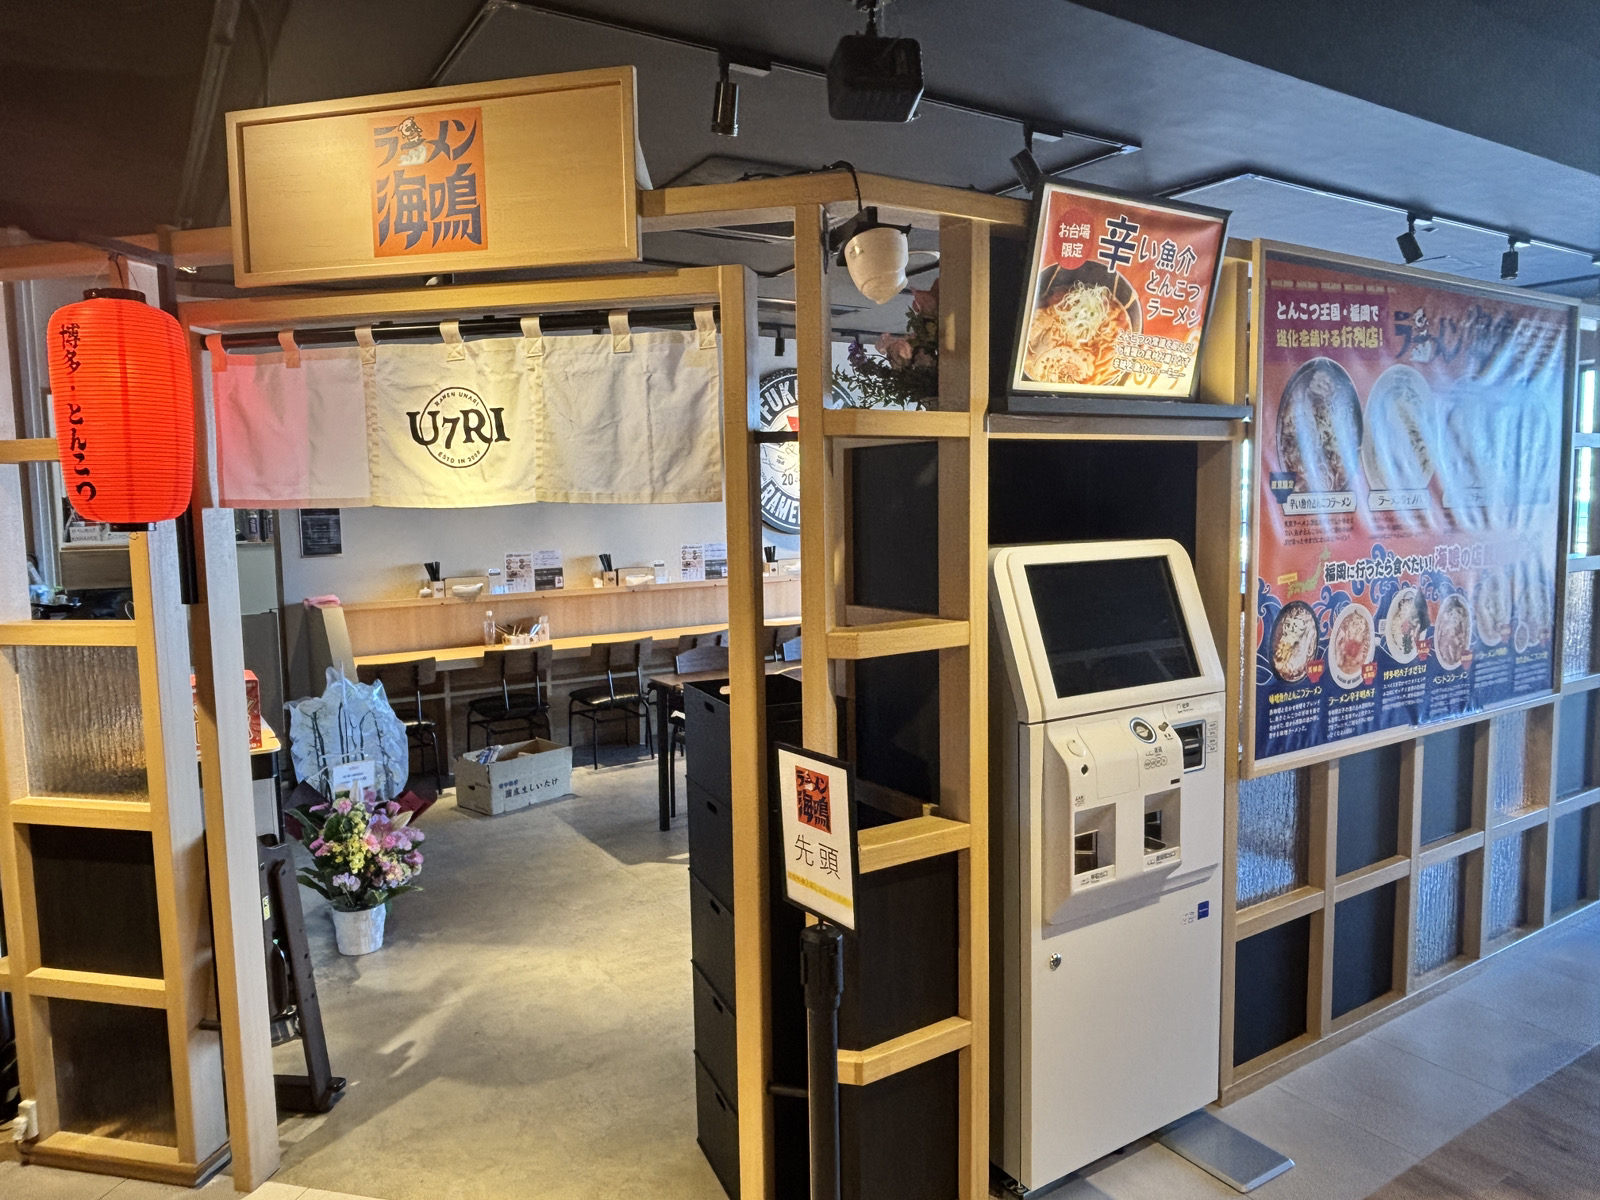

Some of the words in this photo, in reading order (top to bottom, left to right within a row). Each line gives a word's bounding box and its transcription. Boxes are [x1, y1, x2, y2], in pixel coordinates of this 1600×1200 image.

[373, 118, 477, 168] ラーメン
[376, 162, 482, 250] 海鳴
[1058, 222, 1091, 240] お台場
[1097, 214, 1198, 277] 辛い魚介
[1061, 242, 1084, 258] 限定
[1144, 269, 1202, 303] とんこつ
[1146, 298, 1202, 329] ラーメン
[1276, 301, 1379, 323] とんこつ王国・福岡で
[1276, 325, 1384, 349] 進化を続ける行列店!
[434, 391, 456, 407] RAMEN
[458, 391, 480, 407] UNARI
[794, 834, 841, 880] 先頭
